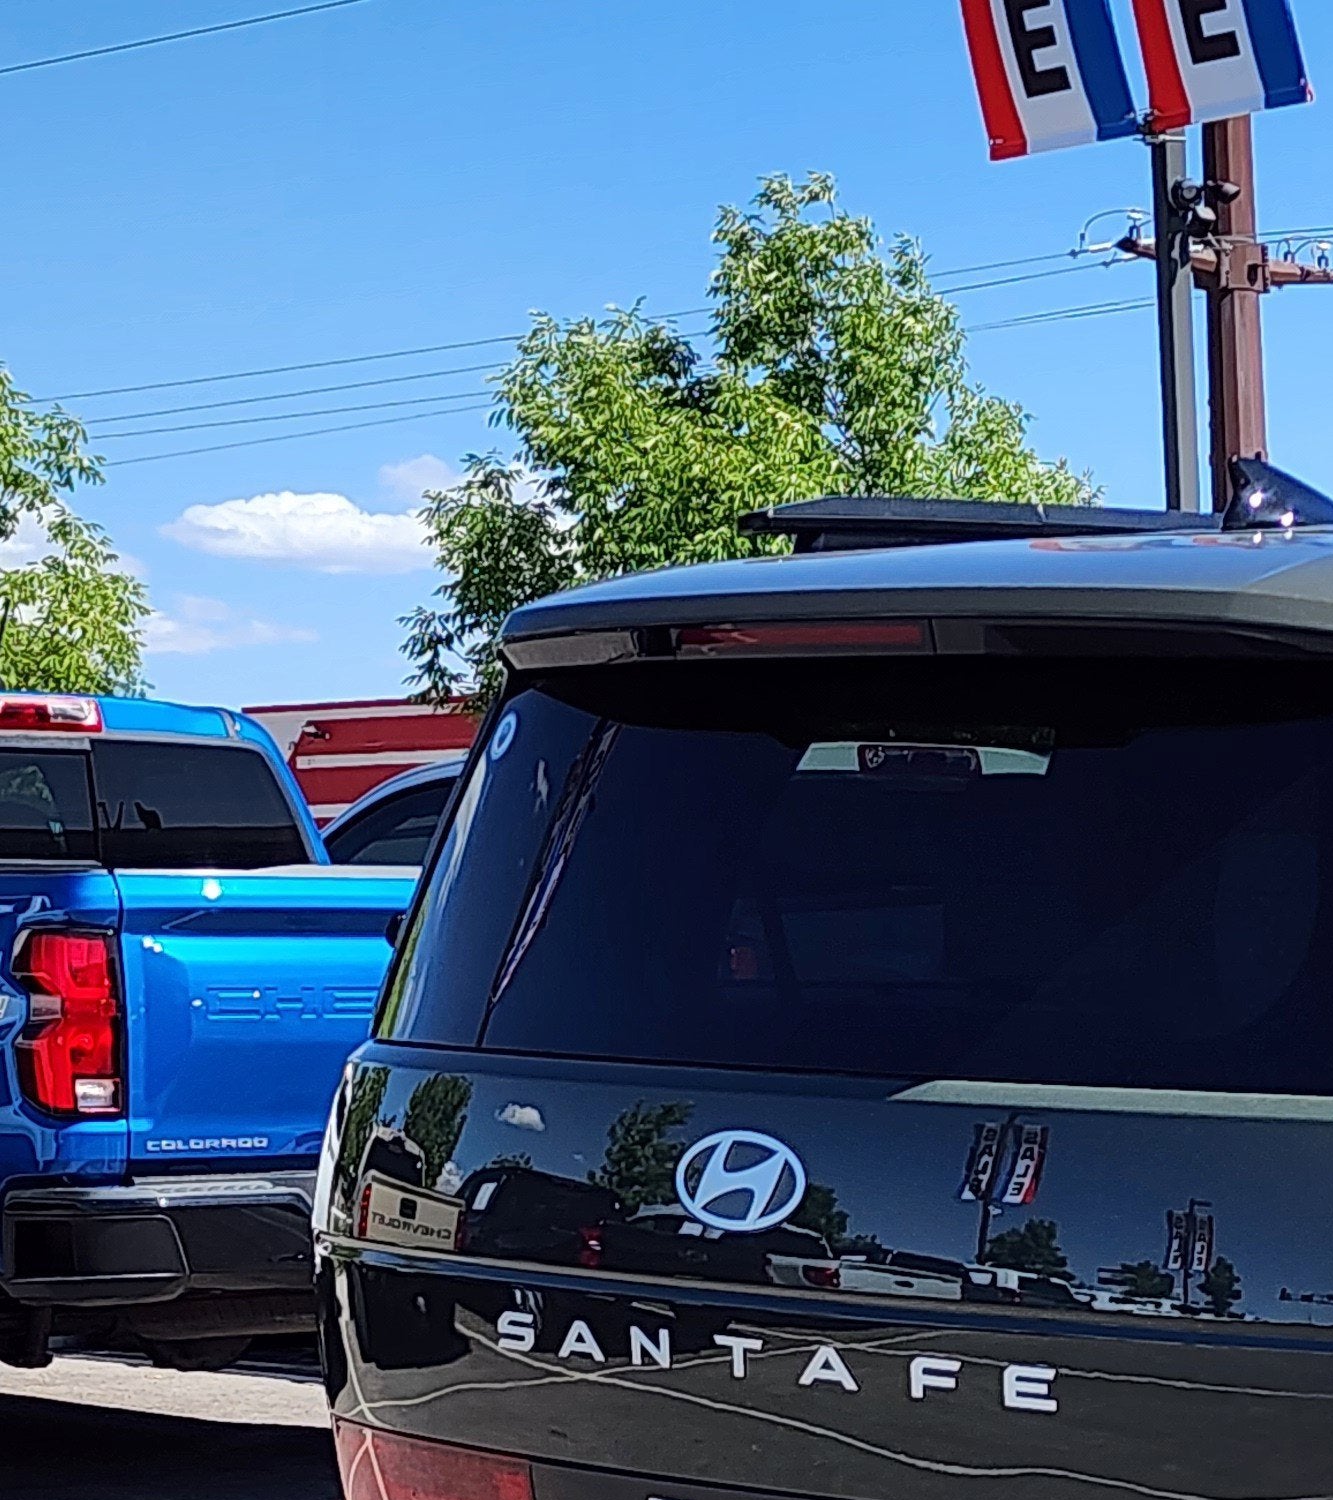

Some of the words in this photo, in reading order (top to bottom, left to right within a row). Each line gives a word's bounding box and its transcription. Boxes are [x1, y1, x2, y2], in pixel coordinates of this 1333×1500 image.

[146, 1136, 269, 1151] COLORADO
[497, 1311, 859, 1392] SANTA
[910, 1355, 1058, 1413] FE
